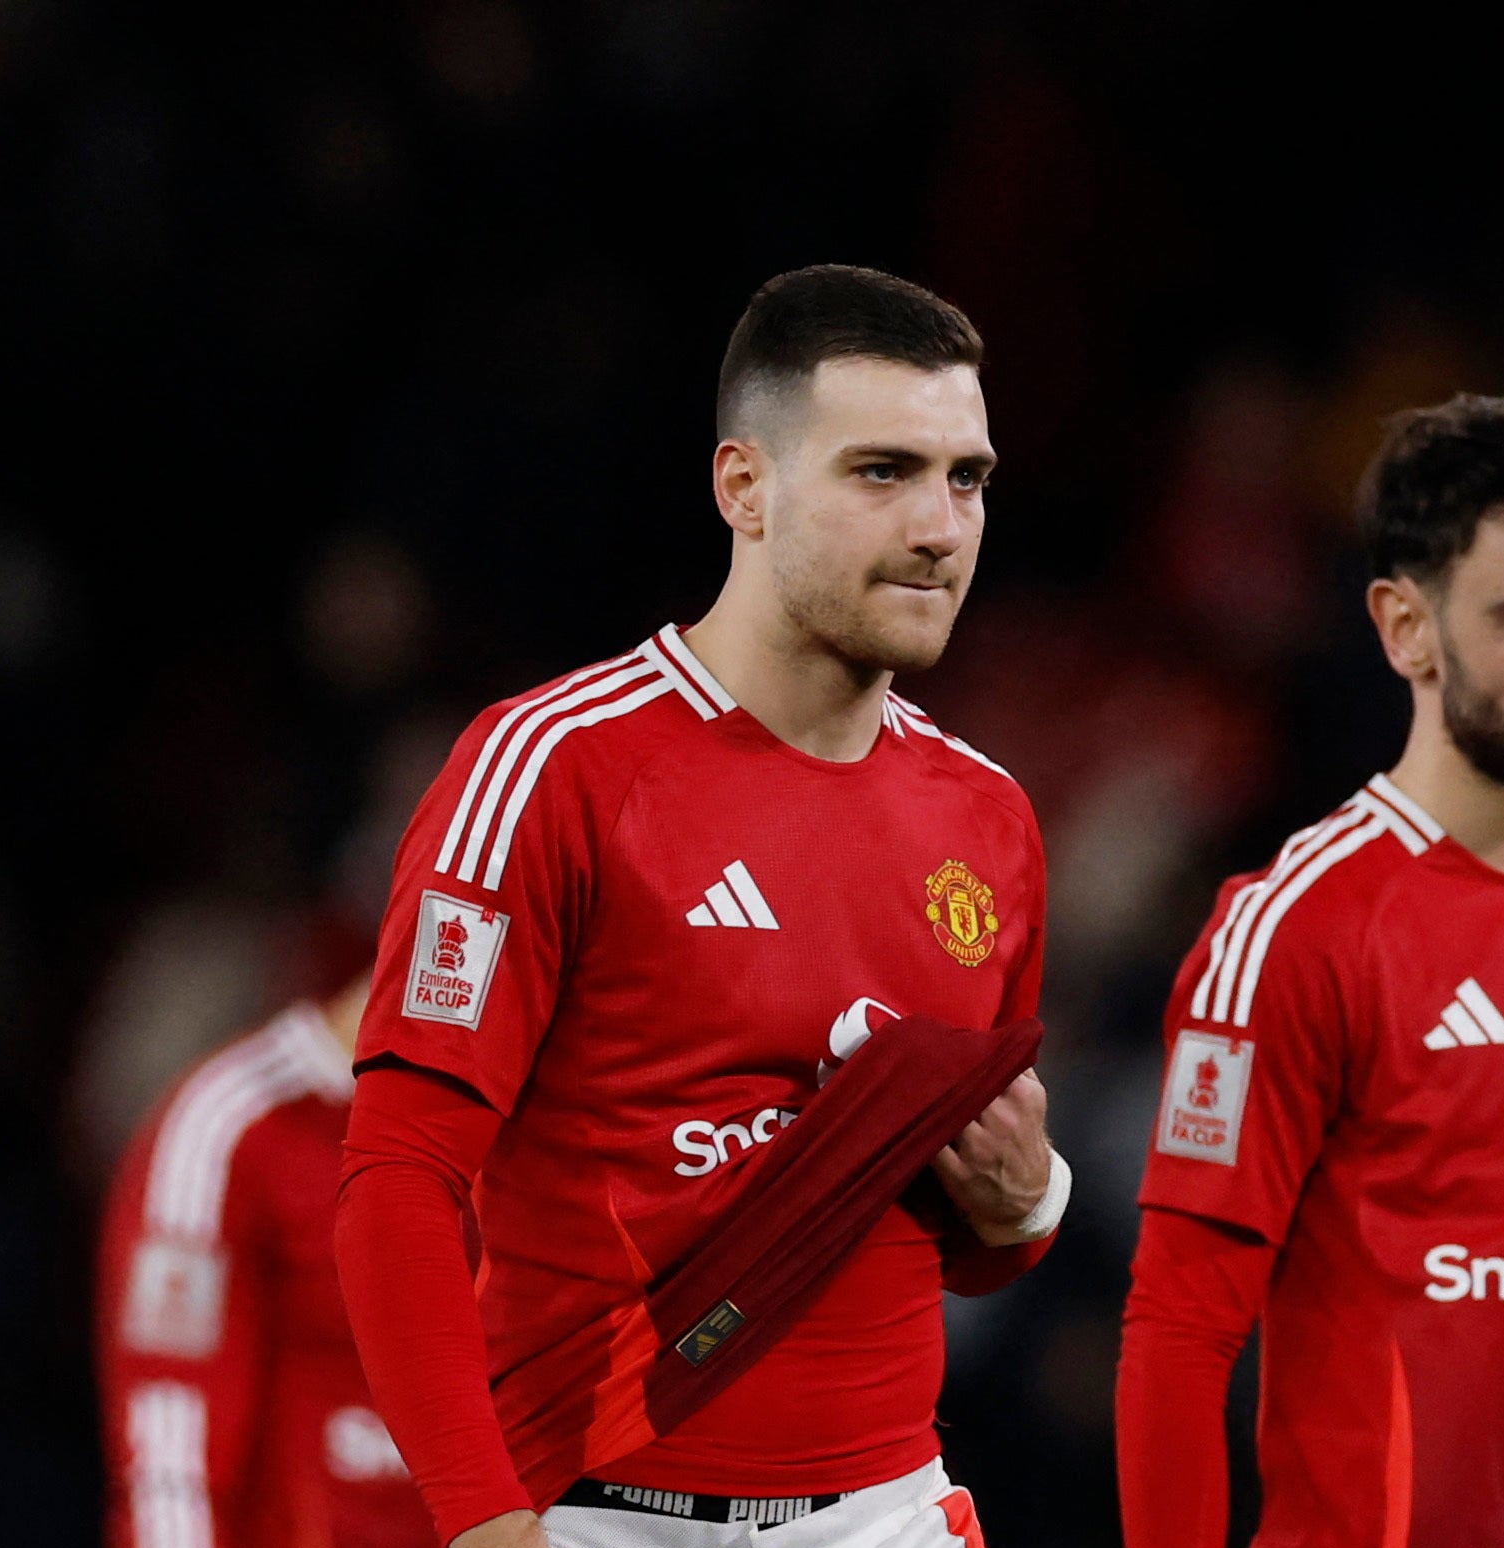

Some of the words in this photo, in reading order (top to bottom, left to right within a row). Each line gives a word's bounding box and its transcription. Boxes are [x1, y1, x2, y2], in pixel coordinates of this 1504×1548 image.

[931, 867, 988, 906] MANCHESTER
[947, 938, 986, 959] UNITED
[418, 969, 474, 994] Emirates
[415, 986, 432, 1006] FA
[435, 990, 471, 1009] CUP
